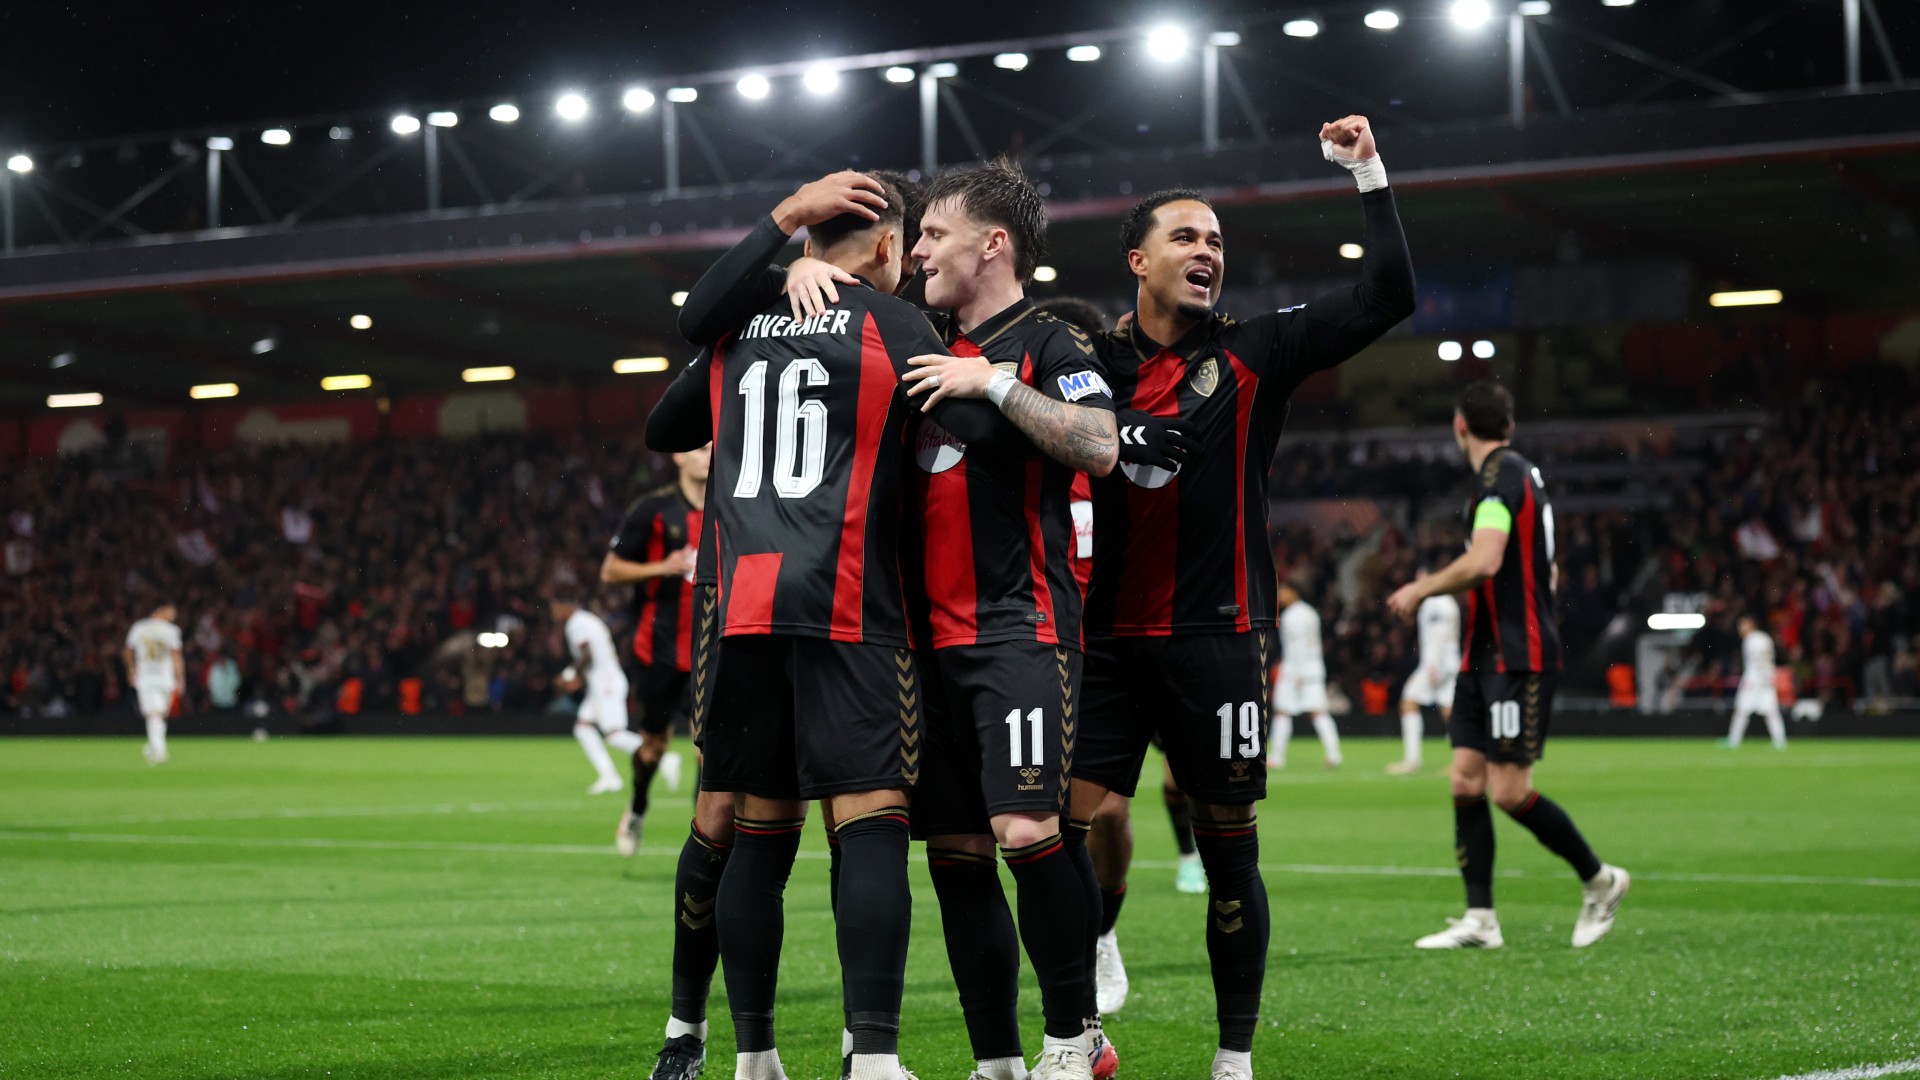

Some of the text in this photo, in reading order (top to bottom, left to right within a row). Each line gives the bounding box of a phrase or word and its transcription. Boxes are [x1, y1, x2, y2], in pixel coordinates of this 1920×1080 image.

[733, 358, 830, 498] 16
[1005, 707, 1044, 767] 11
[1216, 701, 1261, 759] 19
[1489, 700, 1521, 739] 10
